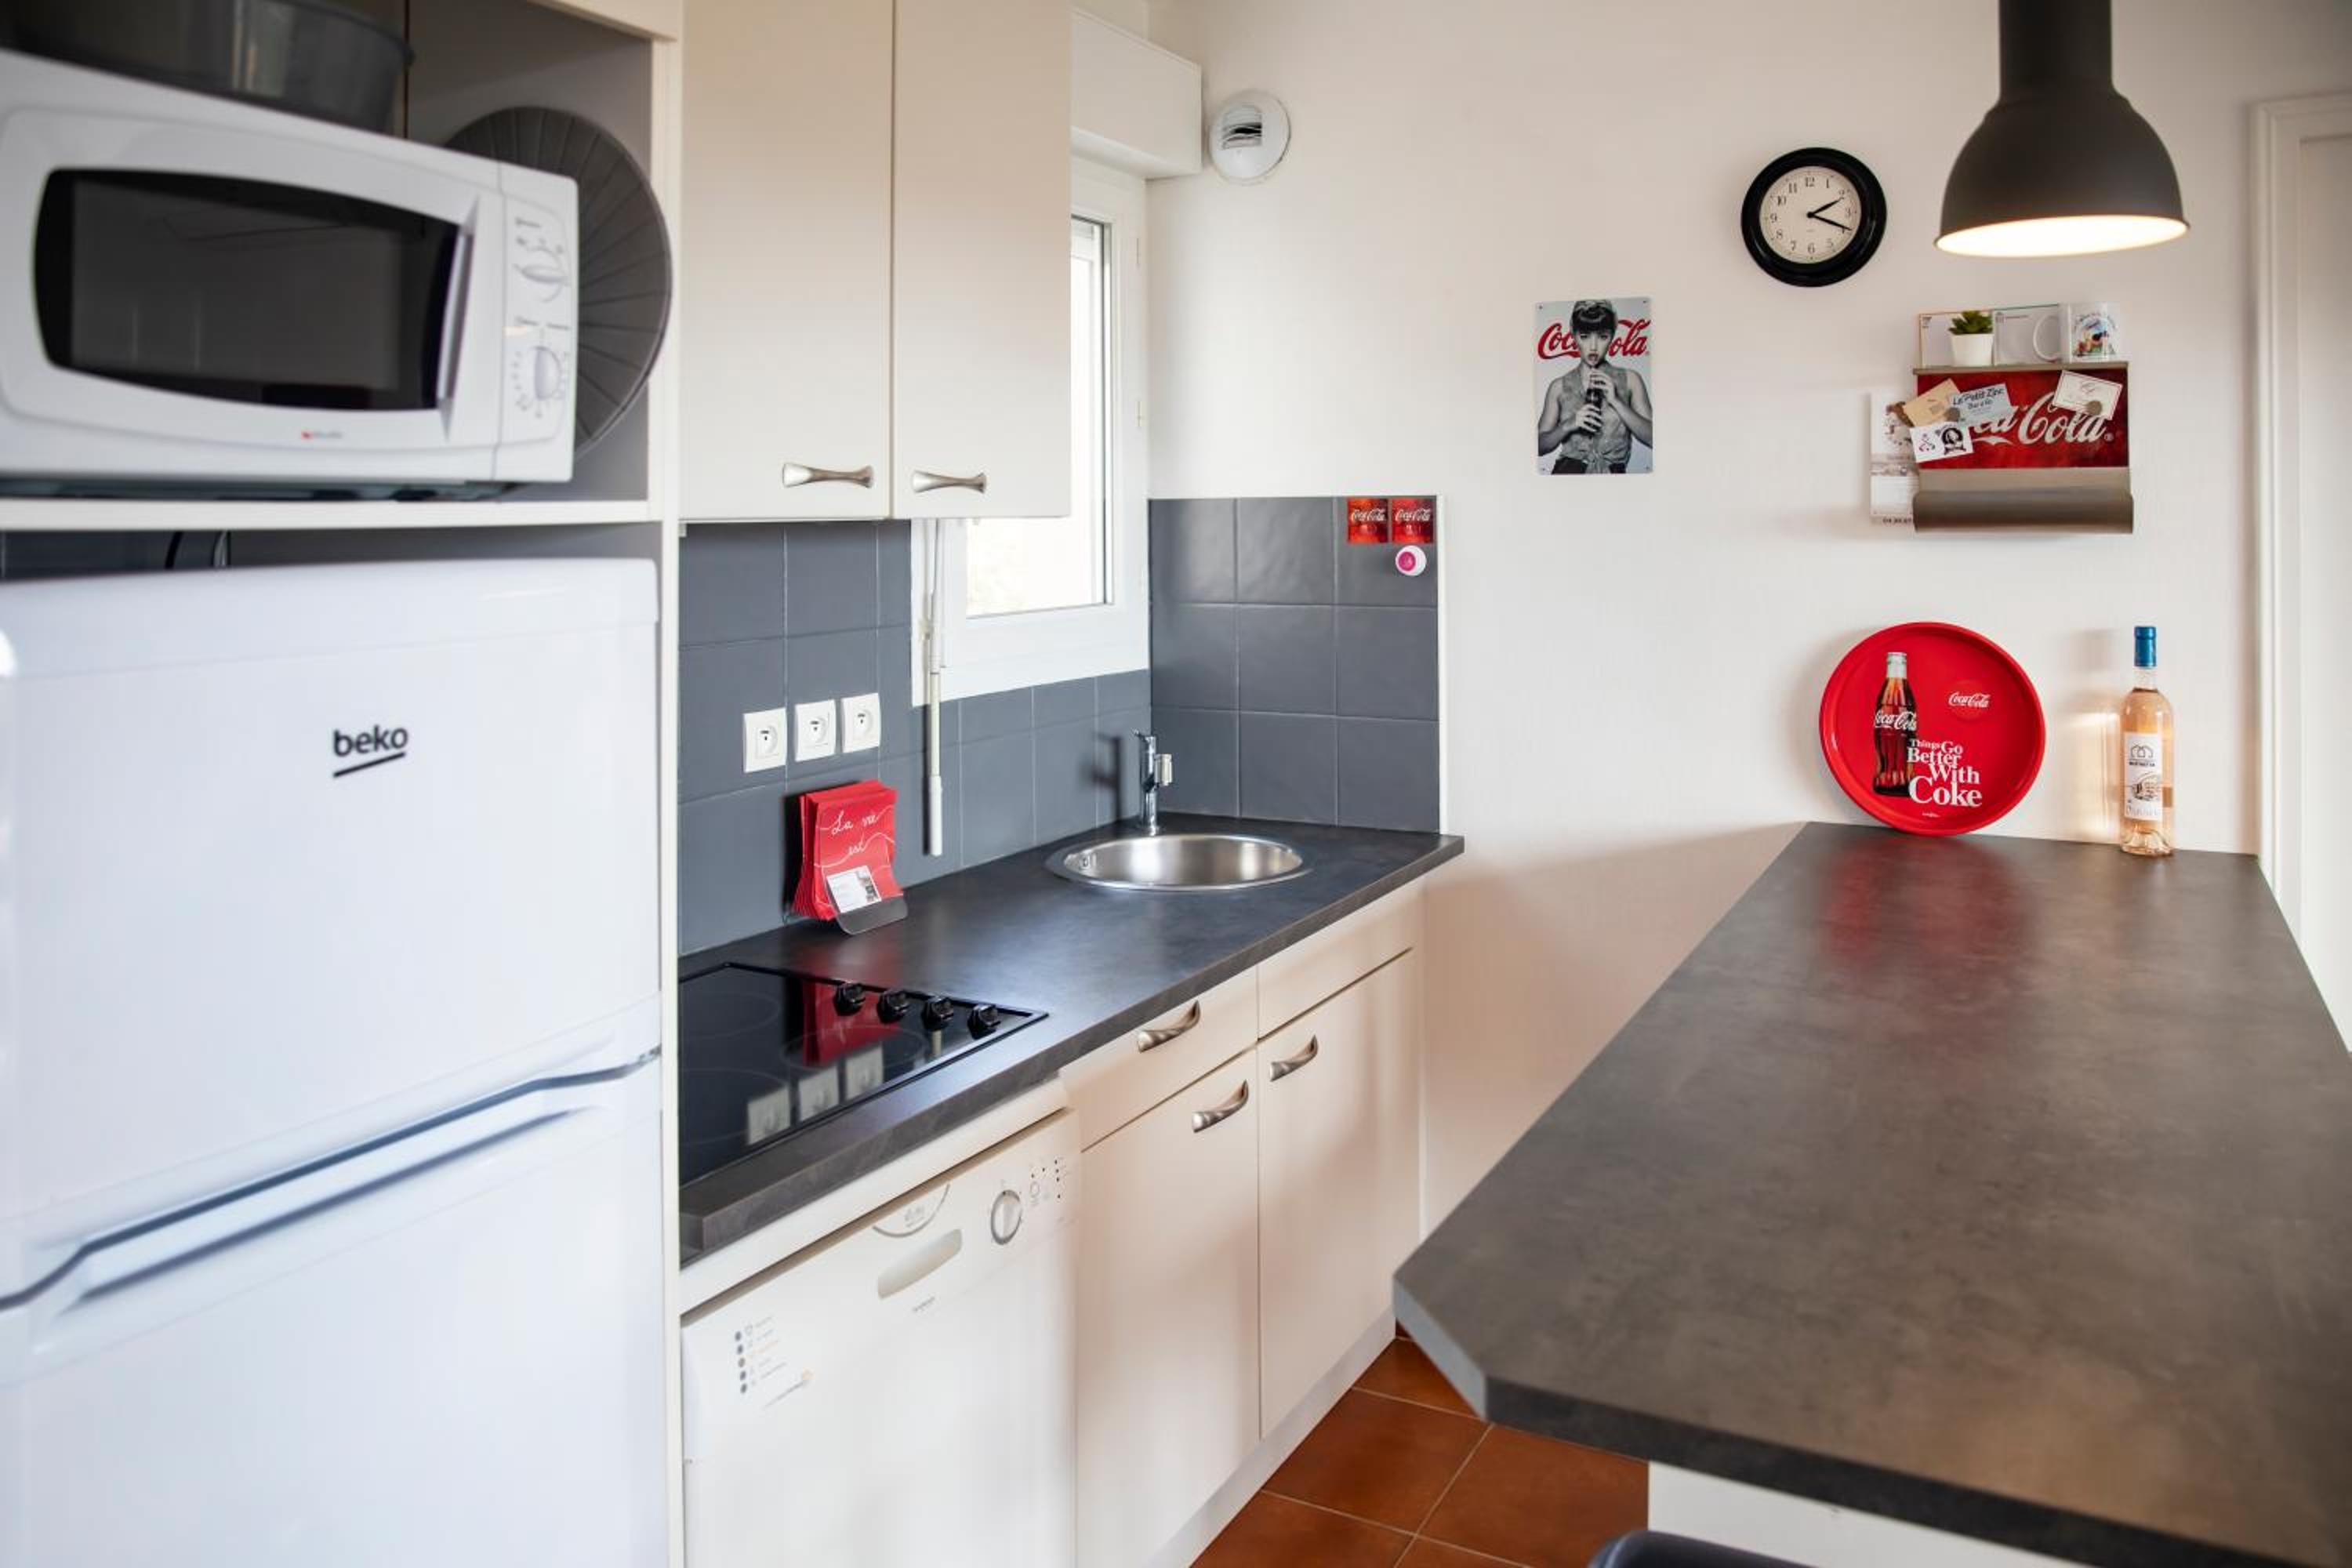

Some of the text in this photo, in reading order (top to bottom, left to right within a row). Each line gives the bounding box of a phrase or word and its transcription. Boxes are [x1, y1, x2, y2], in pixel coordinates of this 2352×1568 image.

[1805, 176, 1815, 187] 12
[1825, 178, 1830, 189] 1
[1788, 183, 1798, 194] 11
[1777, 195, 1787, 206] 10
[1769, 212, 1777, 223] 9
[1776, 228, 1784, 239] 8
[1791, 240, 1797, 251] 7
[1807, 242, 1816, 253] 6
[333, 724, 408, 757] beko
[1910, 739, 1963, 754] Things Go
[1907, 747, 1962, 767] Better
[1929, 764, 1980, 784] With
[1908, 775, 1983, 808] Coke
